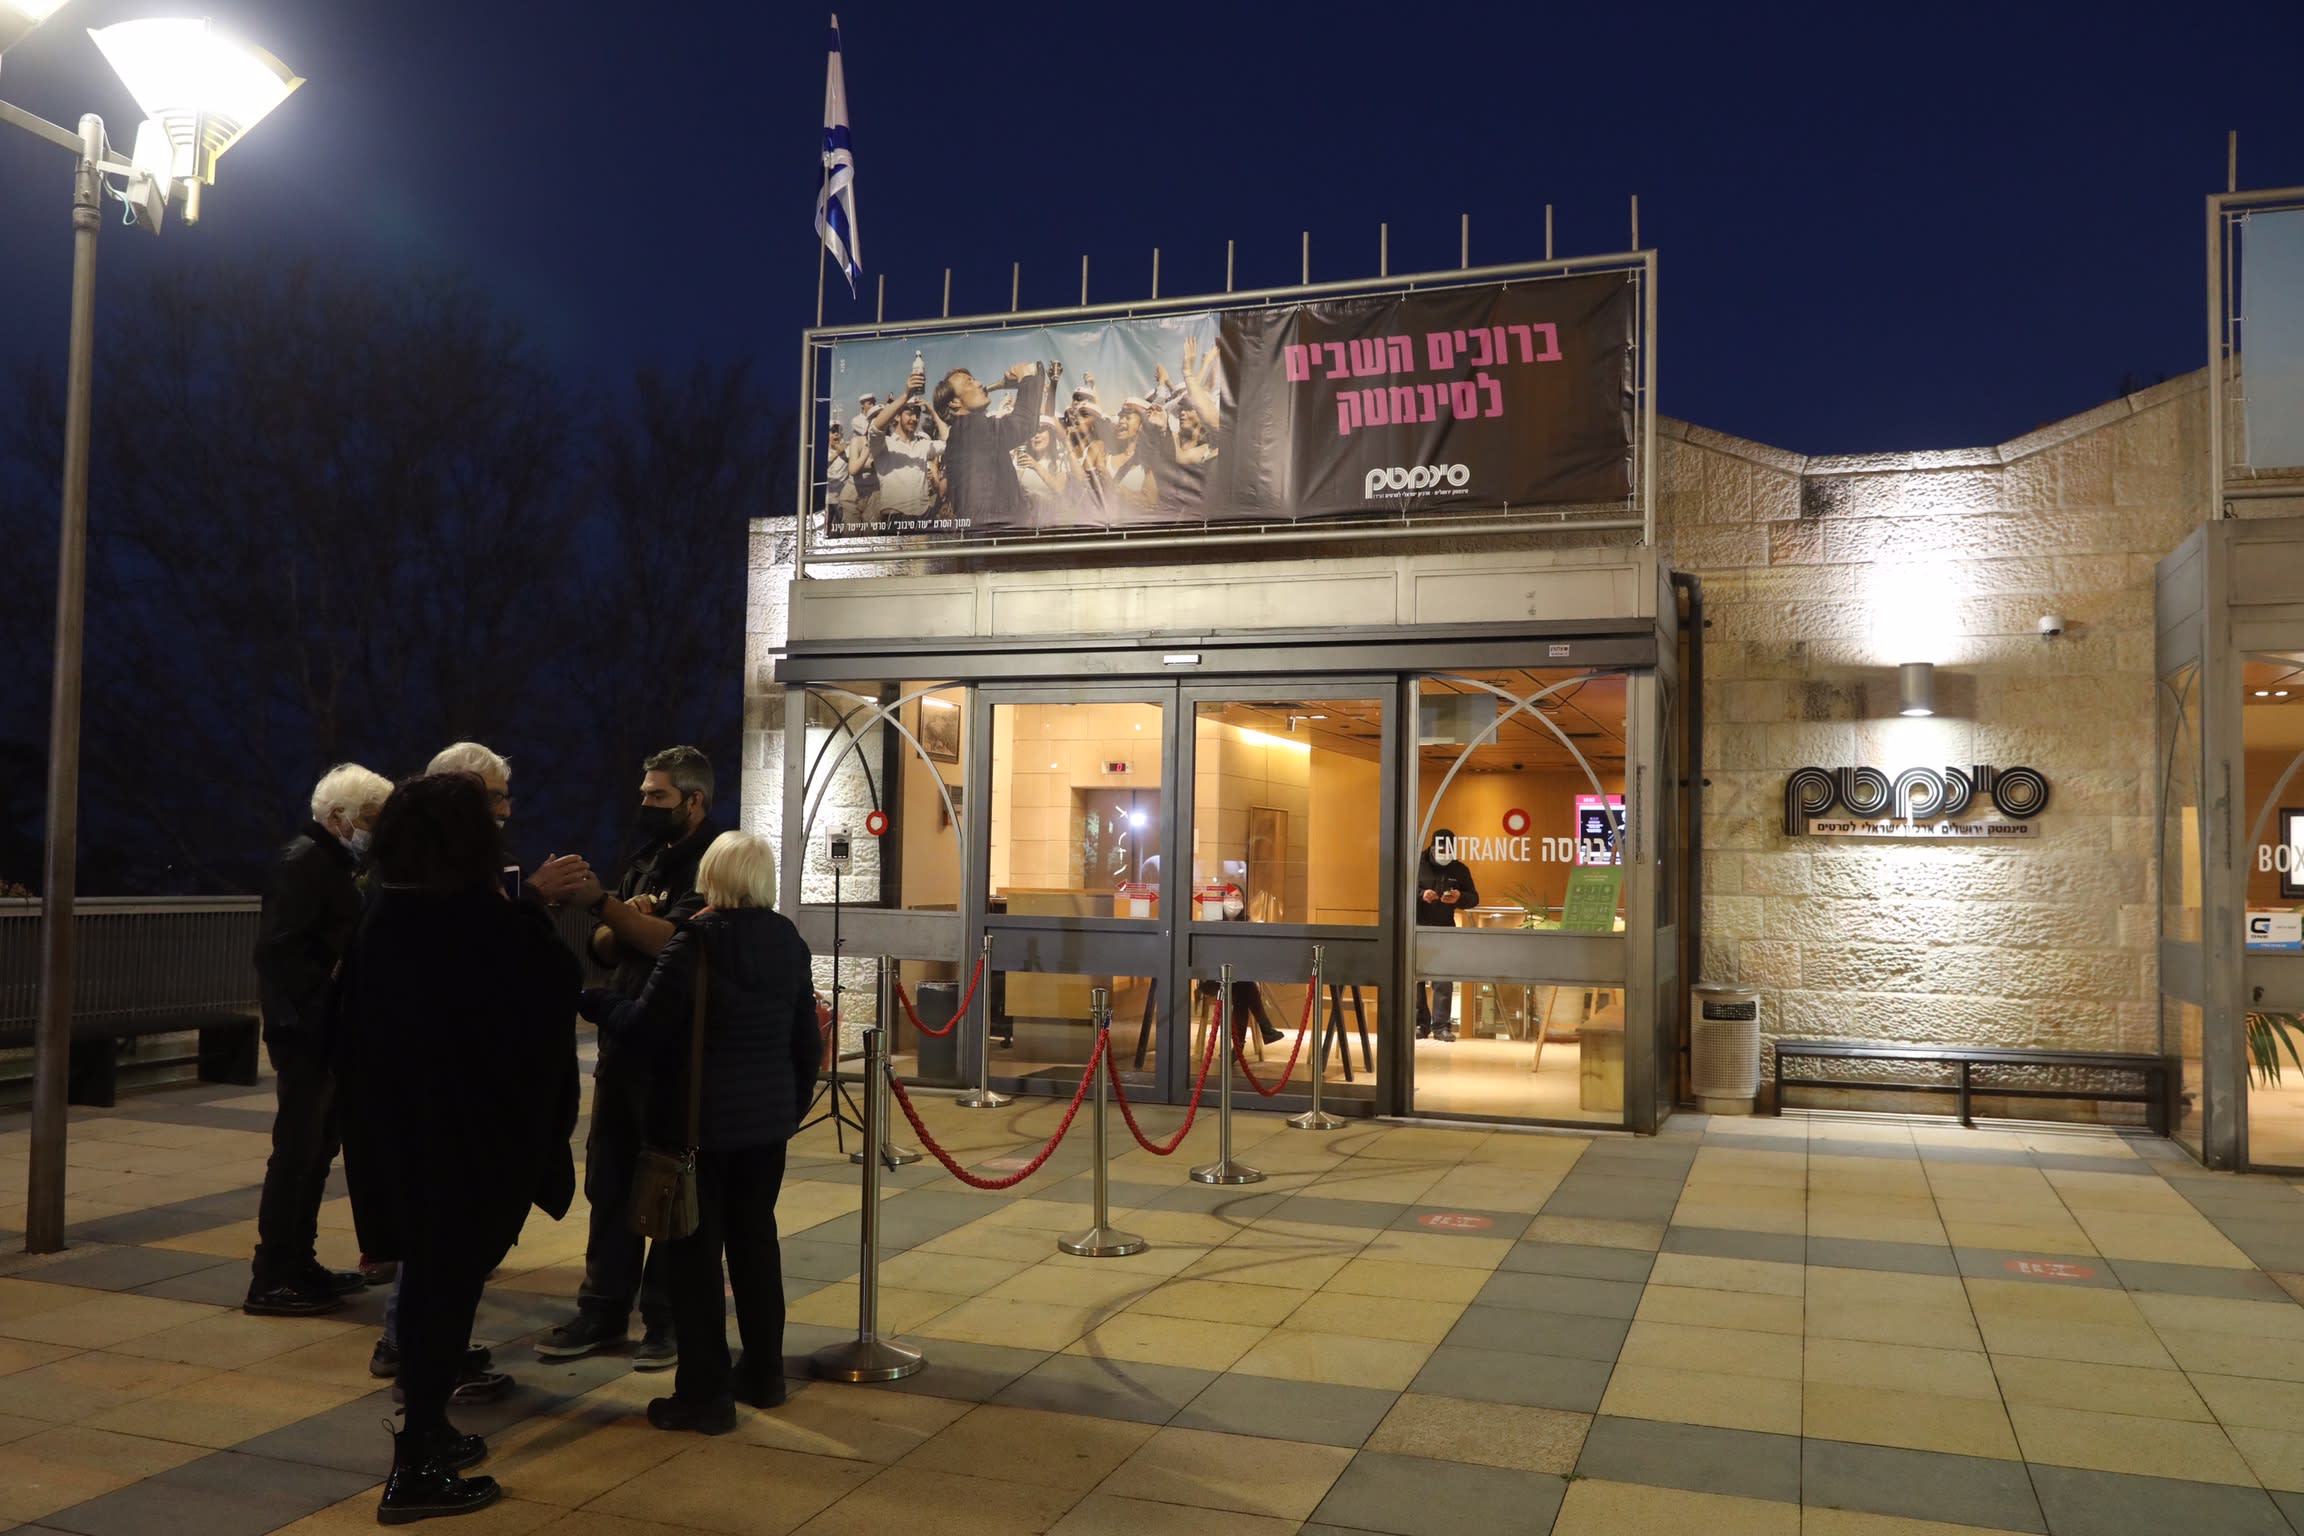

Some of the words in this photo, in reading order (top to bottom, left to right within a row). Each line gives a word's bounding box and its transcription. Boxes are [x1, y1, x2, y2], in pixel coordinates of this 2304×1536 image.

[1284, 335, 1415, 382] השבים
[1426, 322, 1562, 370] ברוכים
[1336, 372, 1504, 436] לסינמטק
[1365, 464, 1470, 499] סינמטק
[1785, 765, 2049, 836] סינמטק
[1817, 820, 1857, 832] לסרטים
[1941, 823, 1983, 835] ירושלים
[1987, 824, 2028, 835] סינמטק
[1435, 836, 1530, 862] ENTRANCE
[1541, 837, 1606, 863] כניסה
